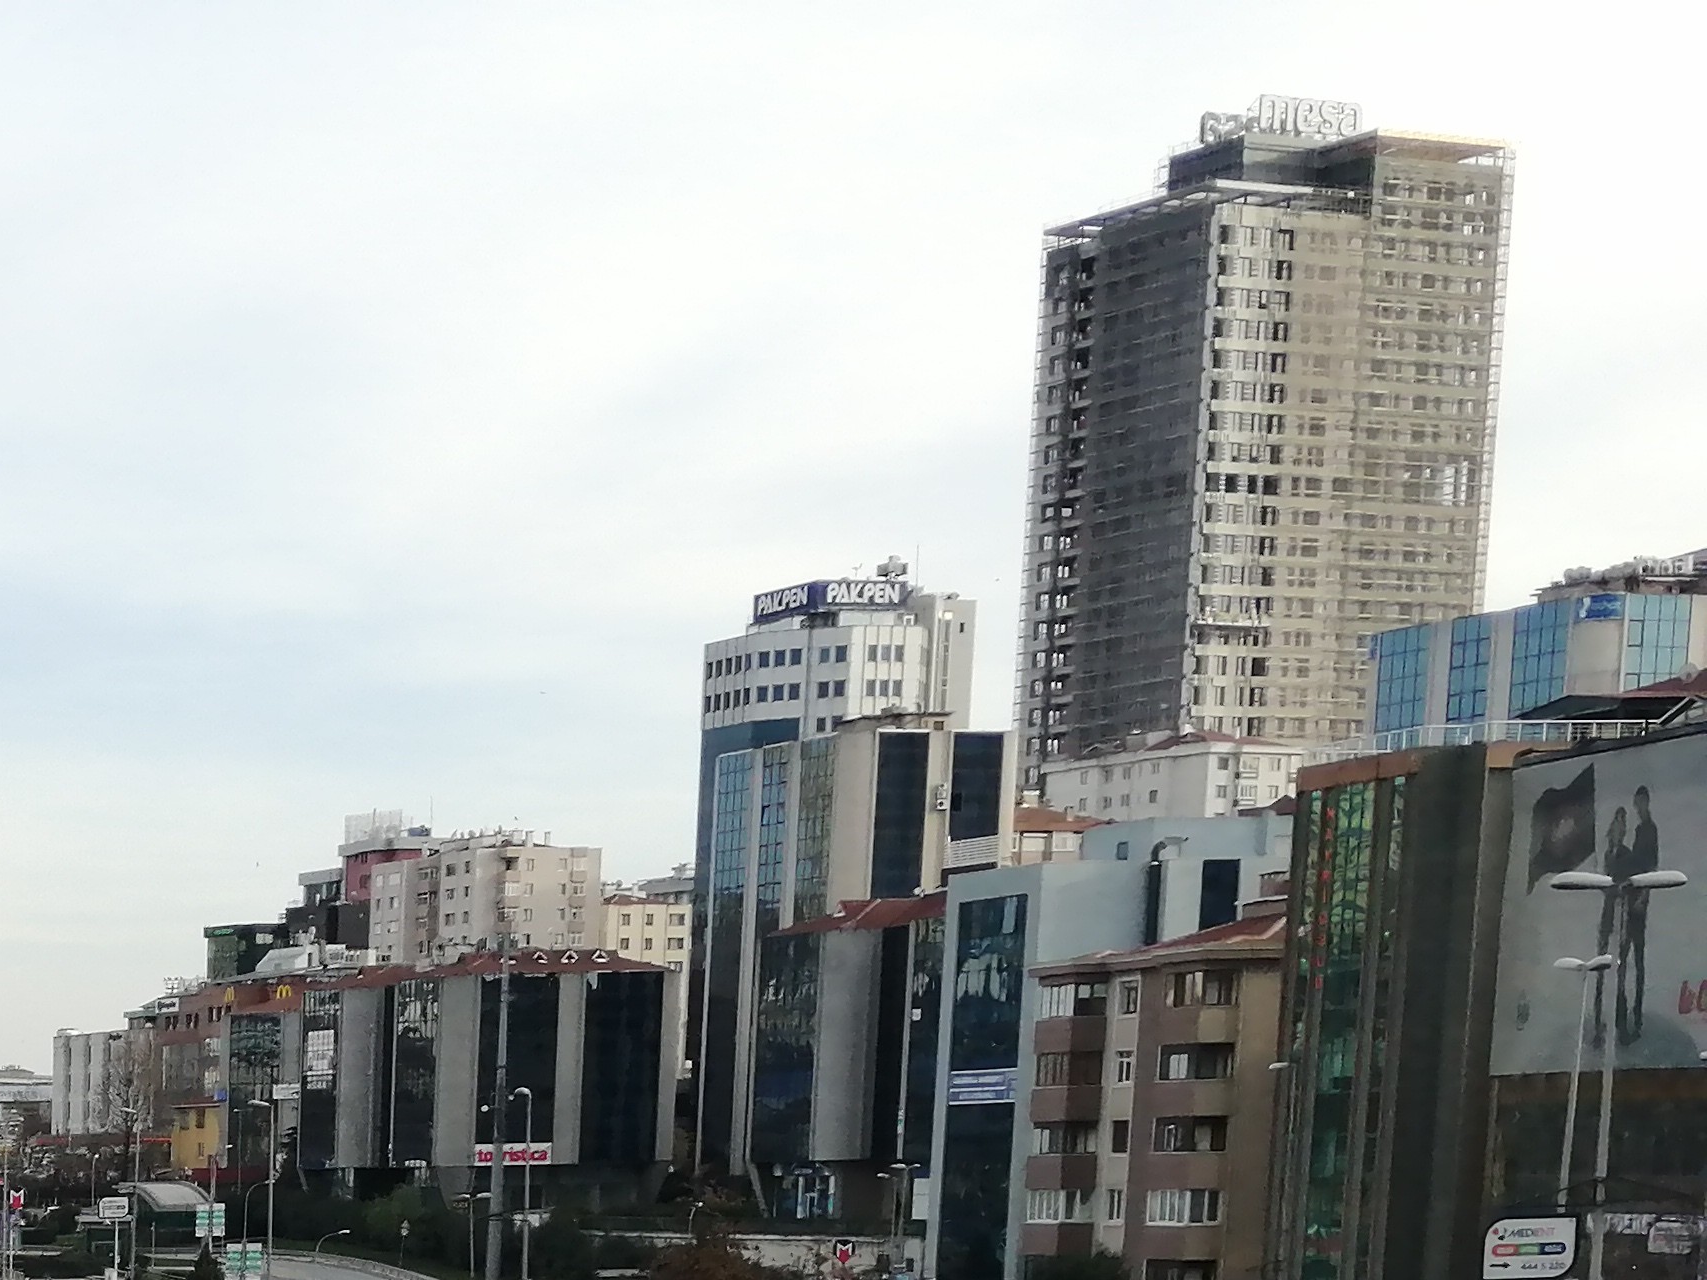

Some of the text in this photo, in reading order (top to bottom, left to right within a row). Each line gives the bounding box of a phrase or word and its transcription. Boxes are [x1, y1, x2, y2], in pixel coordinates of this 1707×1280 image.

[1259, 94, 1363, 137] mesa
[758, 586, 809, 615] PAKPEN
[826, 581, 900, 604] PAKPEN
